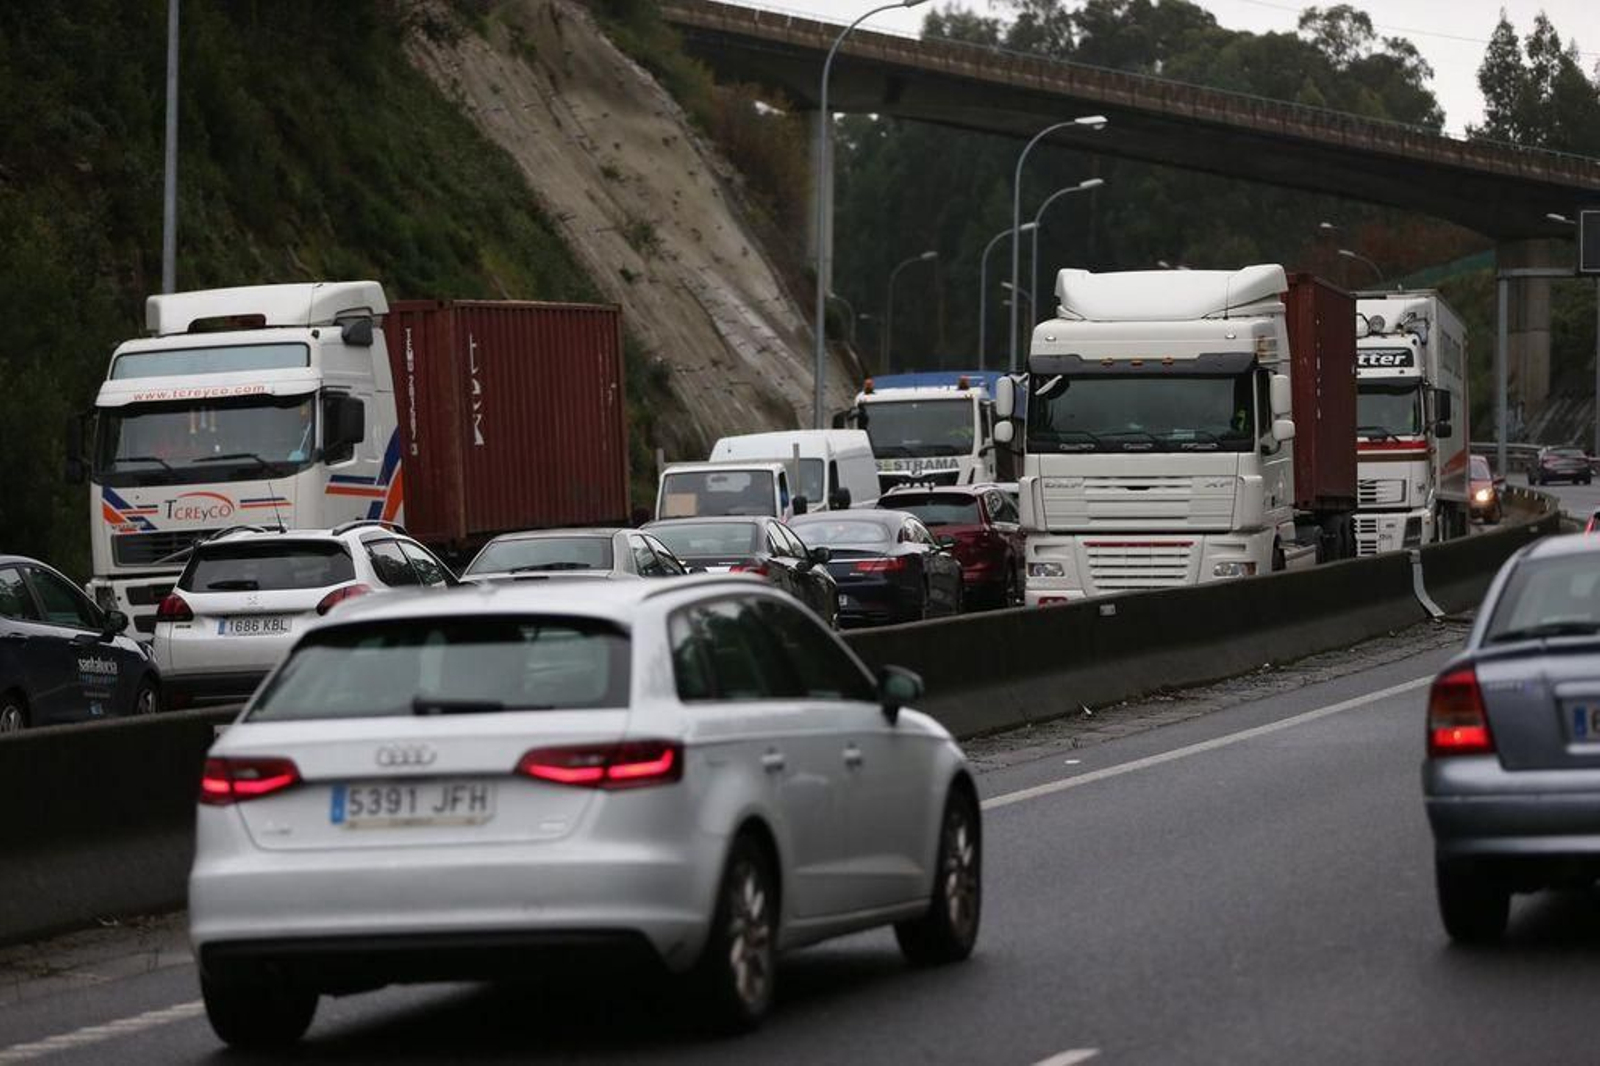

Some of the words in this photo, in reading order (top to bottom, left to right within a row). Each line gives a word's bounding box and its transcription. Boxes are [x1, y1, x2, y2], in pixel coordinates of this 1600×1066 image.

[132, 384, 266, 401] www.tcreyco.com
[228, 620, 260, 633] 1686
[263, 618, 288, 632] KBL
[348, 786, 418, 817] 5391
[432, 784, 489, 813] JFH
